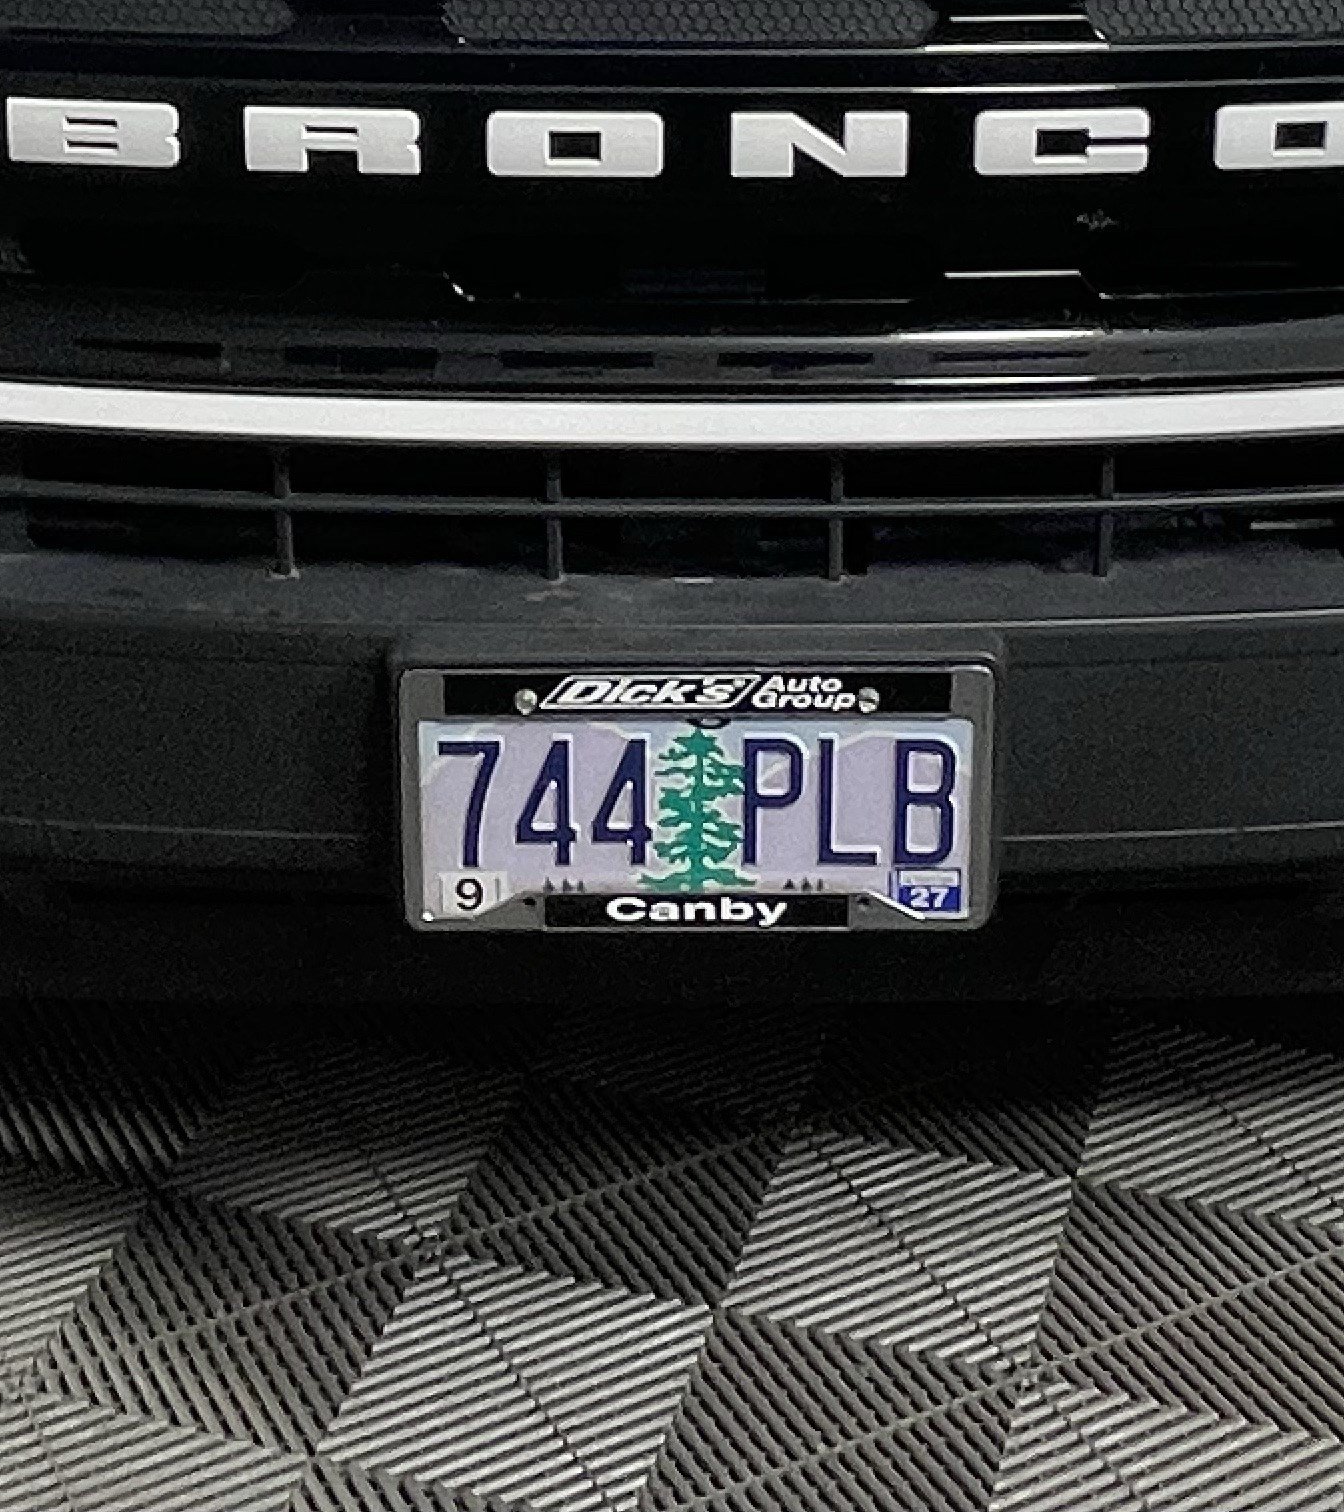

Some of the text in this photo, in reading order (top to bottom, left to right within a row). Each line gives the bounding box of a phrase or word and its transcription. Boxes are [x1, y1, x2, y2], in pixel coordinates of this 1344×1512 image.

[759, 675, 843, 693] Auto
[752, 691, 856, 711] Group
[456, 877, 483, 911] 9
[910, 887, 949, 908] 27
[606, 896, 788, 928] Canby
